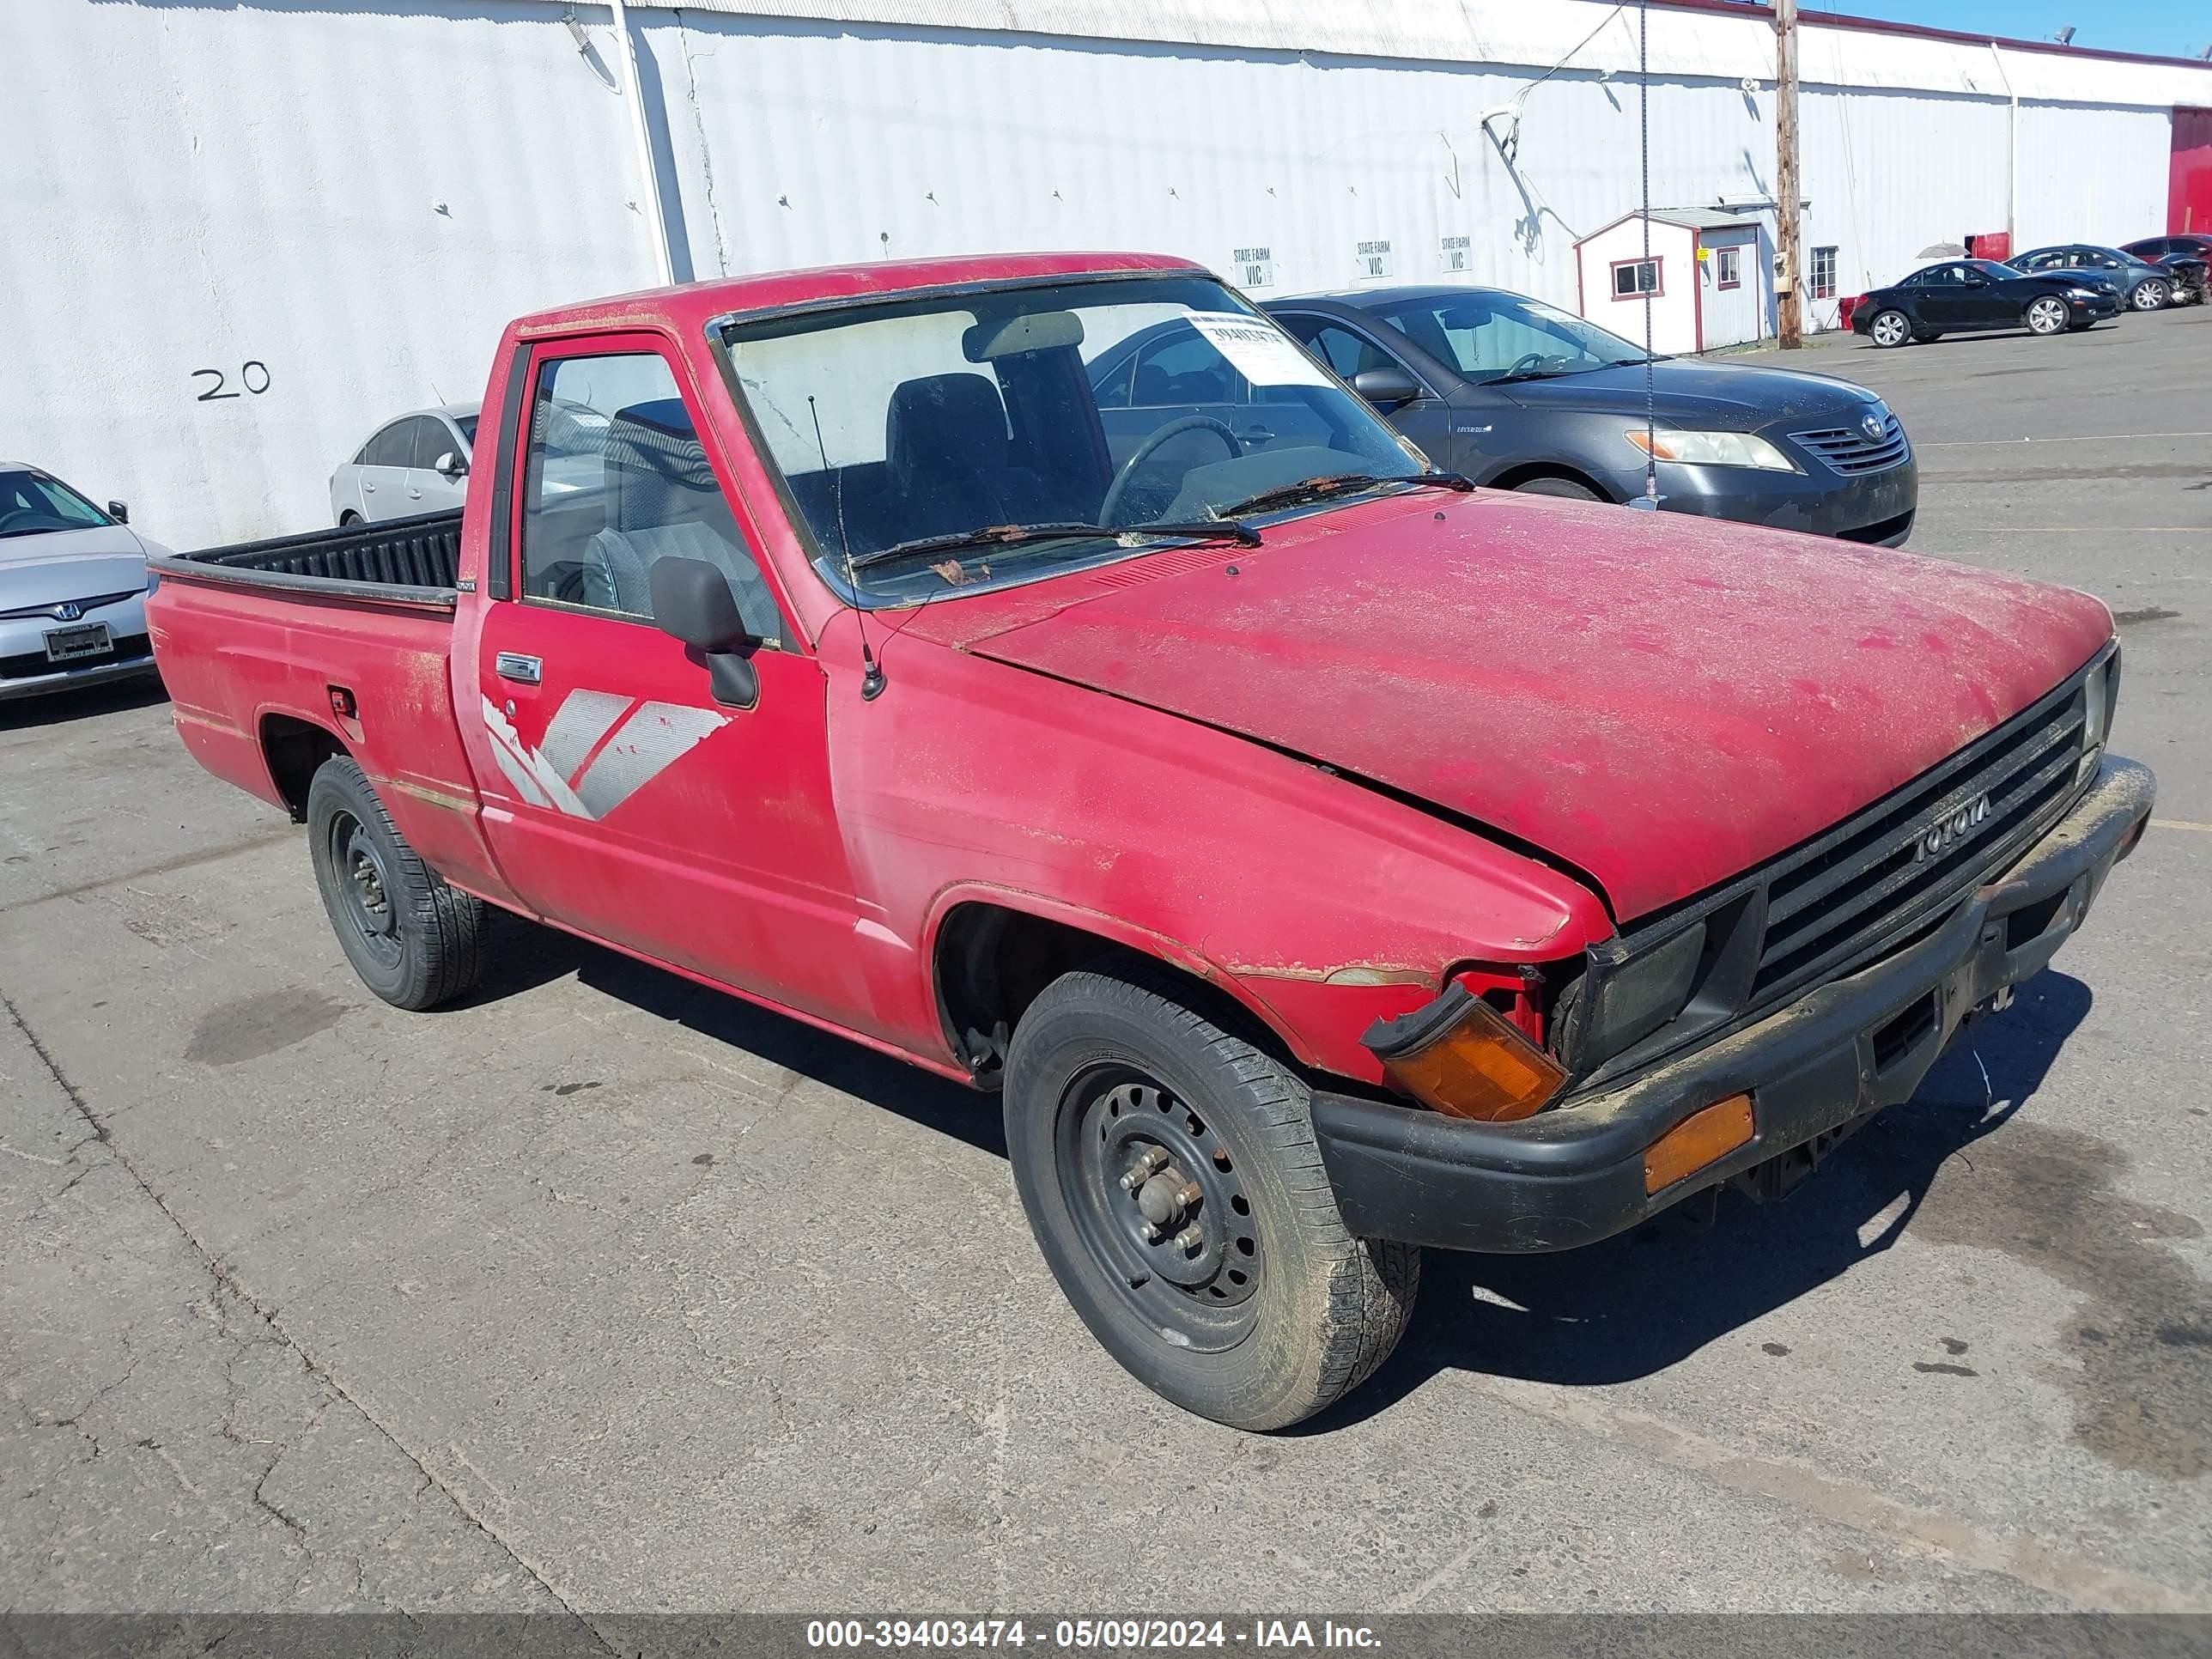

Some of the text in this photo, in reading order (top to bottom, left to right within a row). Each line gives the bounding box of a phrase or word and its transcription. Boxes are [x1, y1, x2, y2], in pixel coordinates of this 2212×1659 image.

[1357, 240, 1390, 254] STATE FARM
[1442, 235, 1471, 250] STATE FARM
[1233, 247, 1271, 263] STATE FARM
[1450, 252, 1464, 270] VIC
[1245, 264, 1262, 285] VIC
[1368, 256, 1382, 276] VIC
[1209, 326, 1285, 345] 39403474
[191, 361, 270, 402] 20
[1914, 793, 1992, 863] TOYOTA
